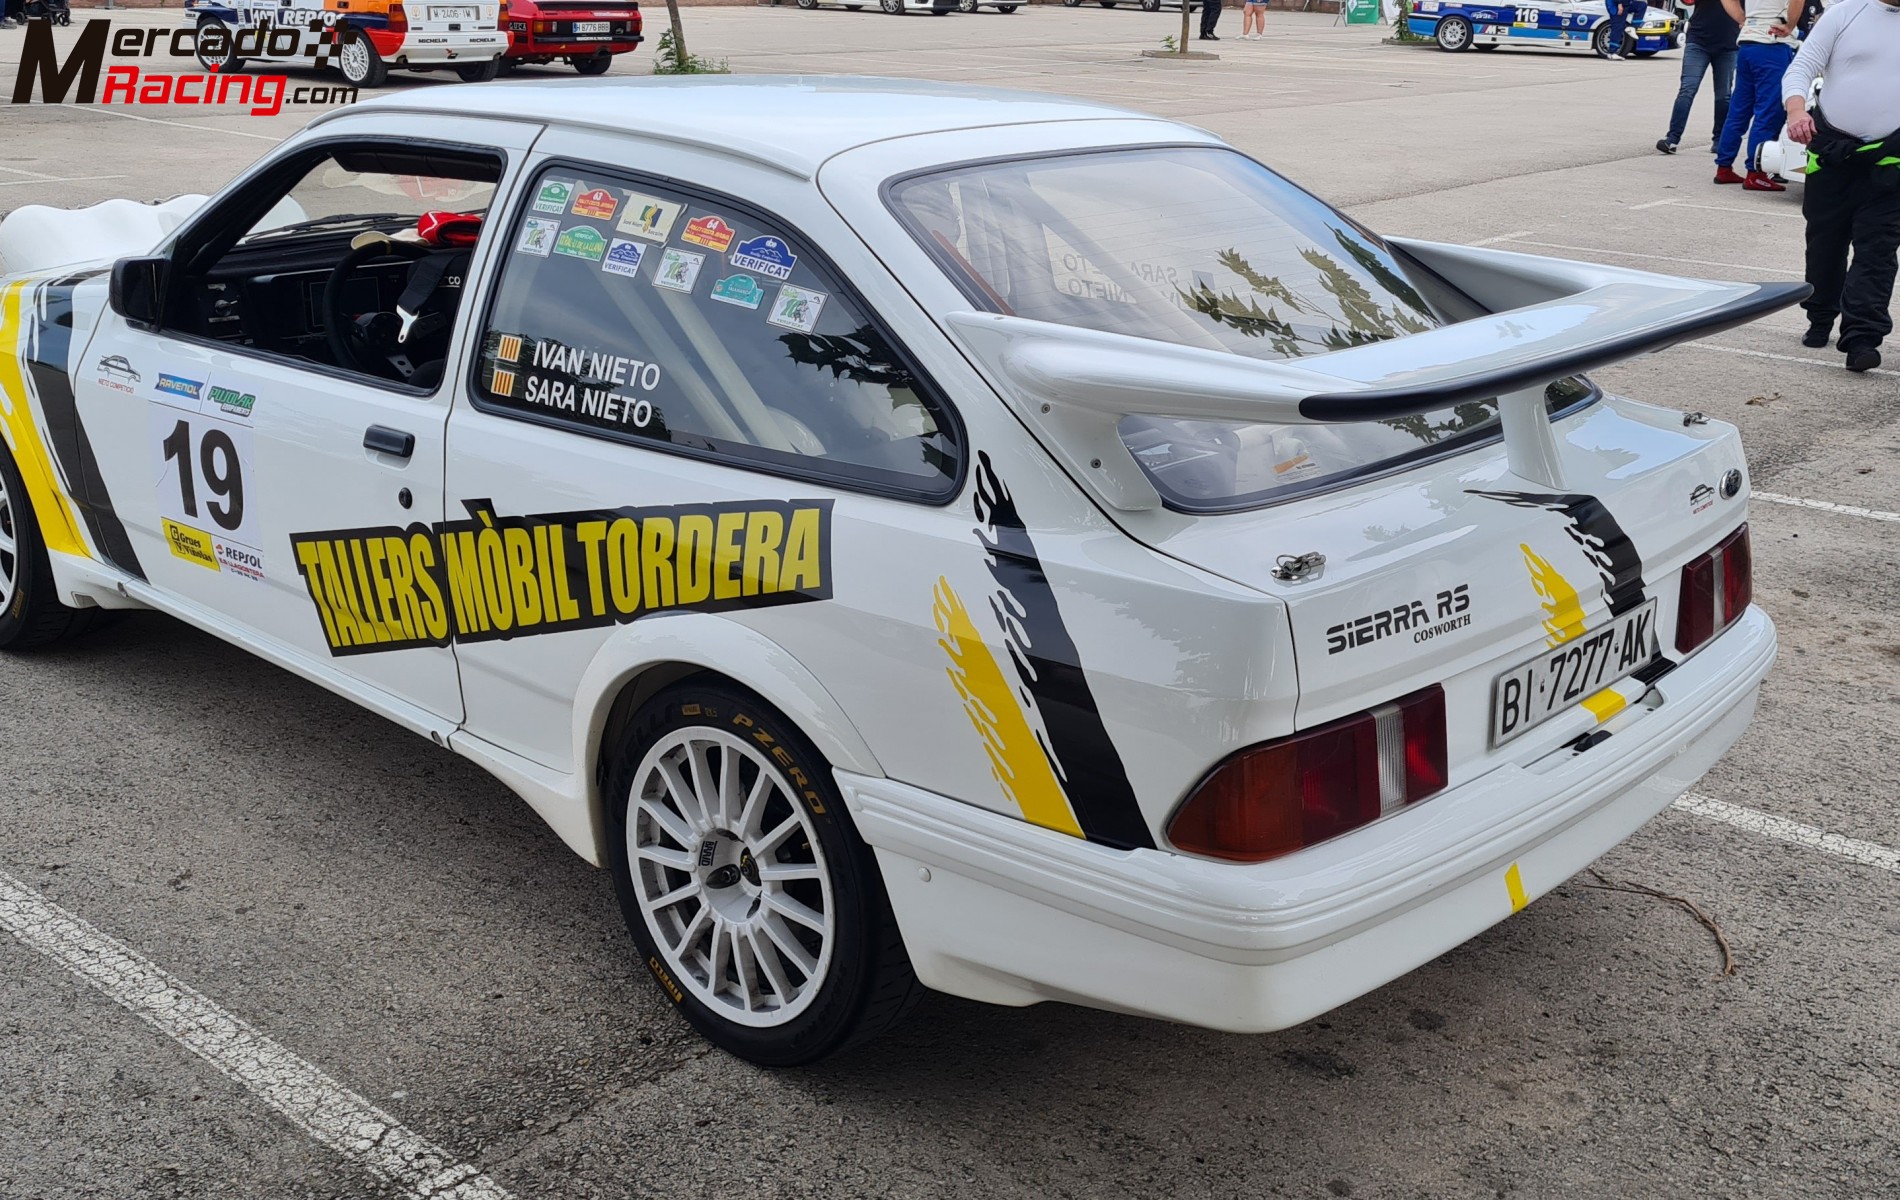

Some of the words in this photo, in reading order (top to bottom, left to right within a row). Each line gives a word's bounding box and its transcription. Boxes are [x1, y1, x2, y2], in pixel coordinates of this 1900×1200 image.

[1515, 8, 1539, 22] 116
[535, 203, 563, 213] VERIFICAT
[707, 219, 718, 230] 64
[604, 263, 636, 276] VERIFICAT
[734, 254, 790, 279] VERIFICAT
[533, 341, 584, 375] IVAN
[588, 352, 661, 391] NIETO
[159, 378, 198, 394] RAVENOL
[525, 375, 575, 412] SARA
[581, 388, 653, 428] NIETO
[163, 419, 243, 531] 19
[226, 547, 262, 569] REPSOL
[296, 532, 448, 648] TALLERS
[440, 510, 579, 635] MÒBIL
[576, 508, 821, 617] TORDERA
[1436, 584, 1470, 619] RS
[1413, 614, 1471, 644] COSWORTH
